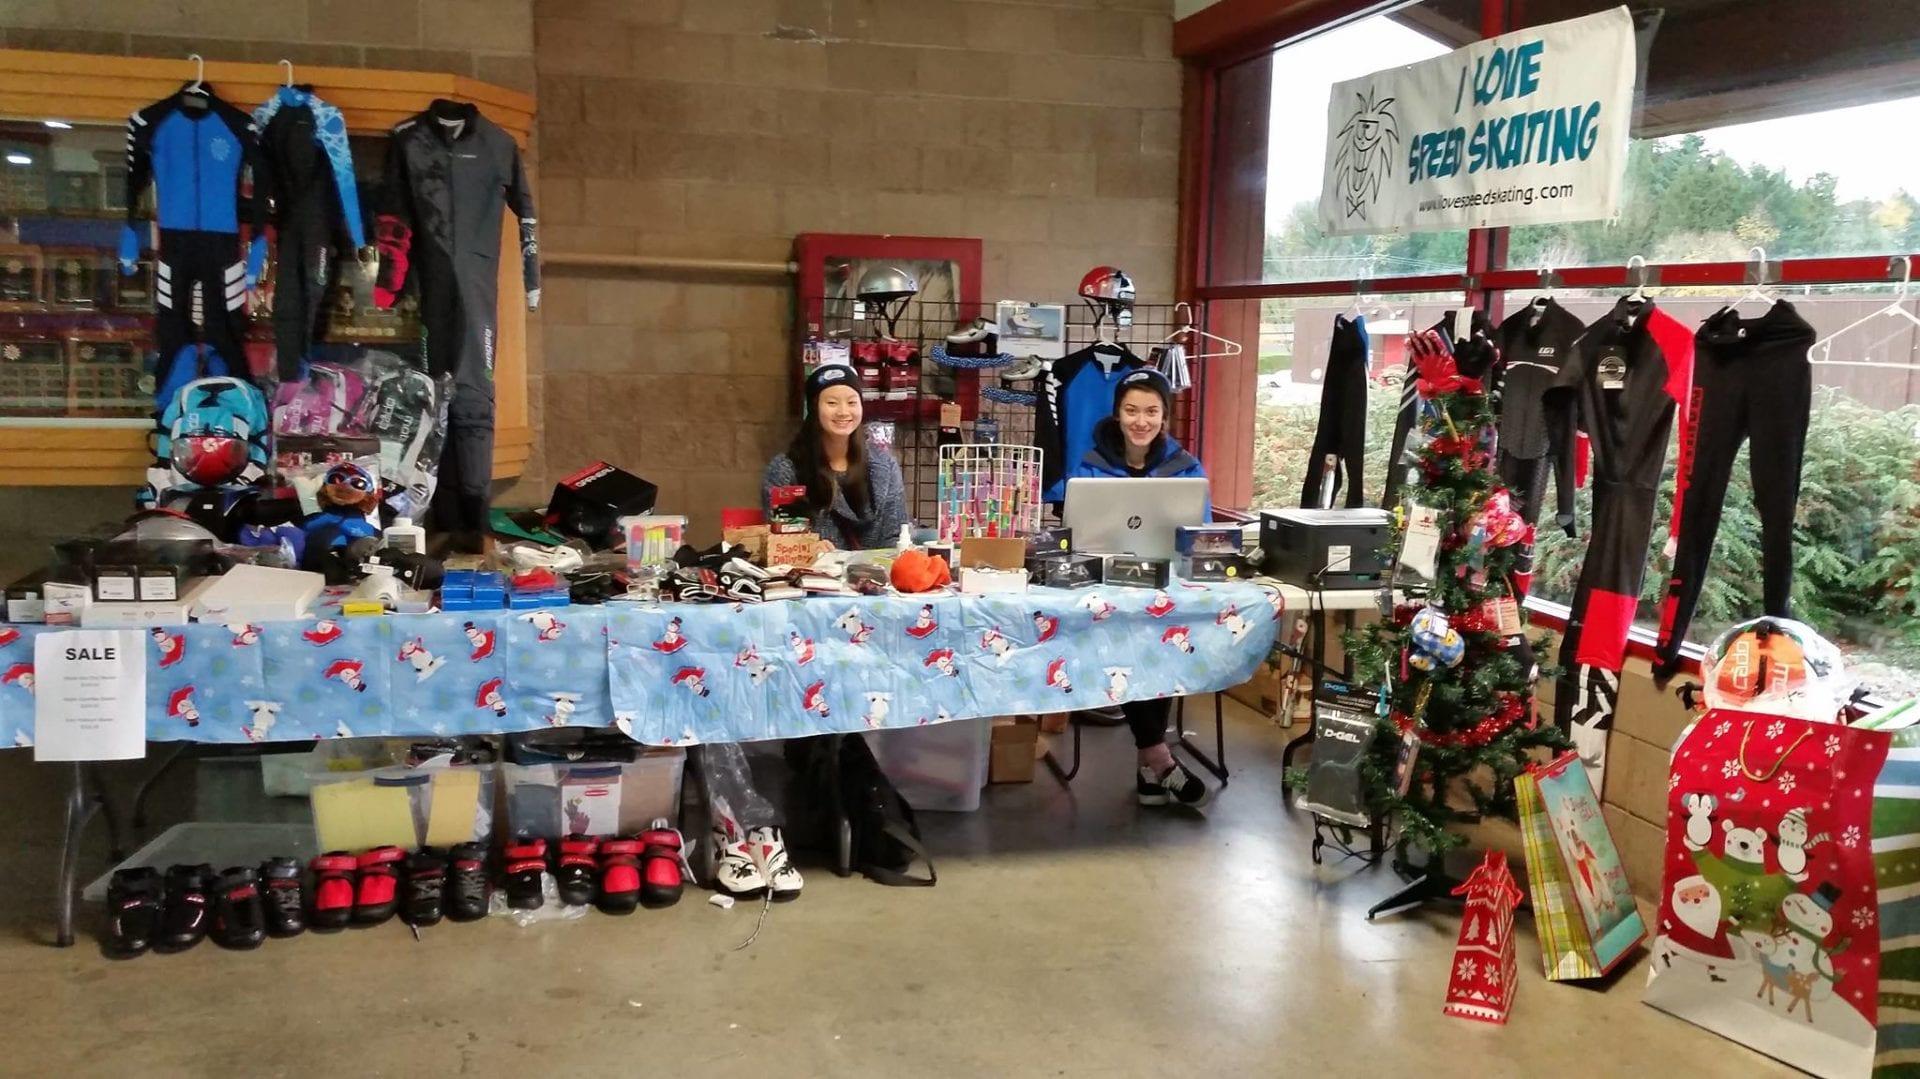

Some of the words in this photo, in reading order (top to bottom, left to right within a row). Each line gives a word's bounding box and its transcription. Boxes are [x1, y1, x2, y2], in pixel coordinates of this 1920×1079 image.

[1455, 65, 1467, 114] I
[1473, 39, 1545, 107] LOVE
[1408, 126, 1466, 184] SPEED
[1468, 100, 1601, 174] SKATING
[65, 647, 116, 661] SALE
